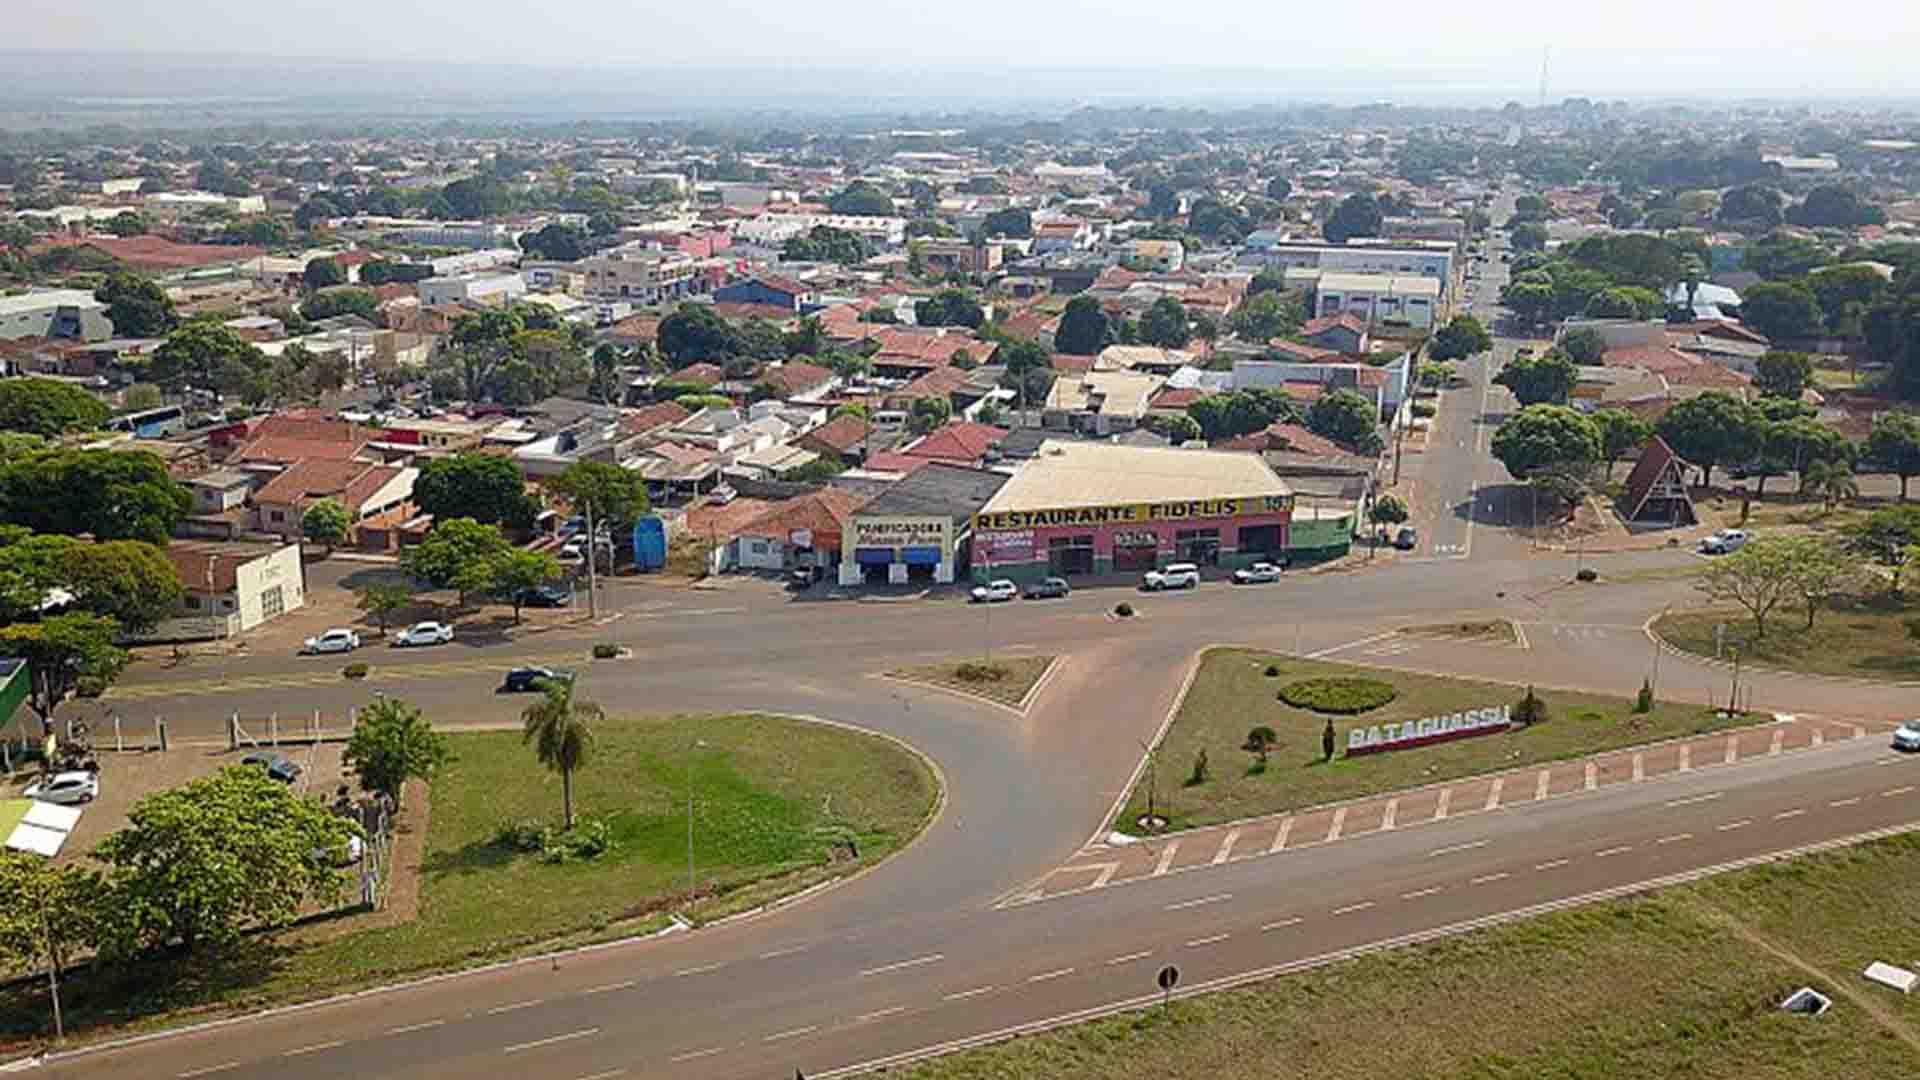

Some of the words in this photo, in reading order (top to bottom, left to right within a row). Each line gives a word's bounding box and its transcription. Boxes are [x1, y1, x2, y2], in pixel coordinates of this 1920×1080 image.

[976, 506, 1136, 528] RESTAURANTE
[1149, 500, 1237, 519] FIDELIS
[1348, 704, 1511, 749] BATAGUASSU
